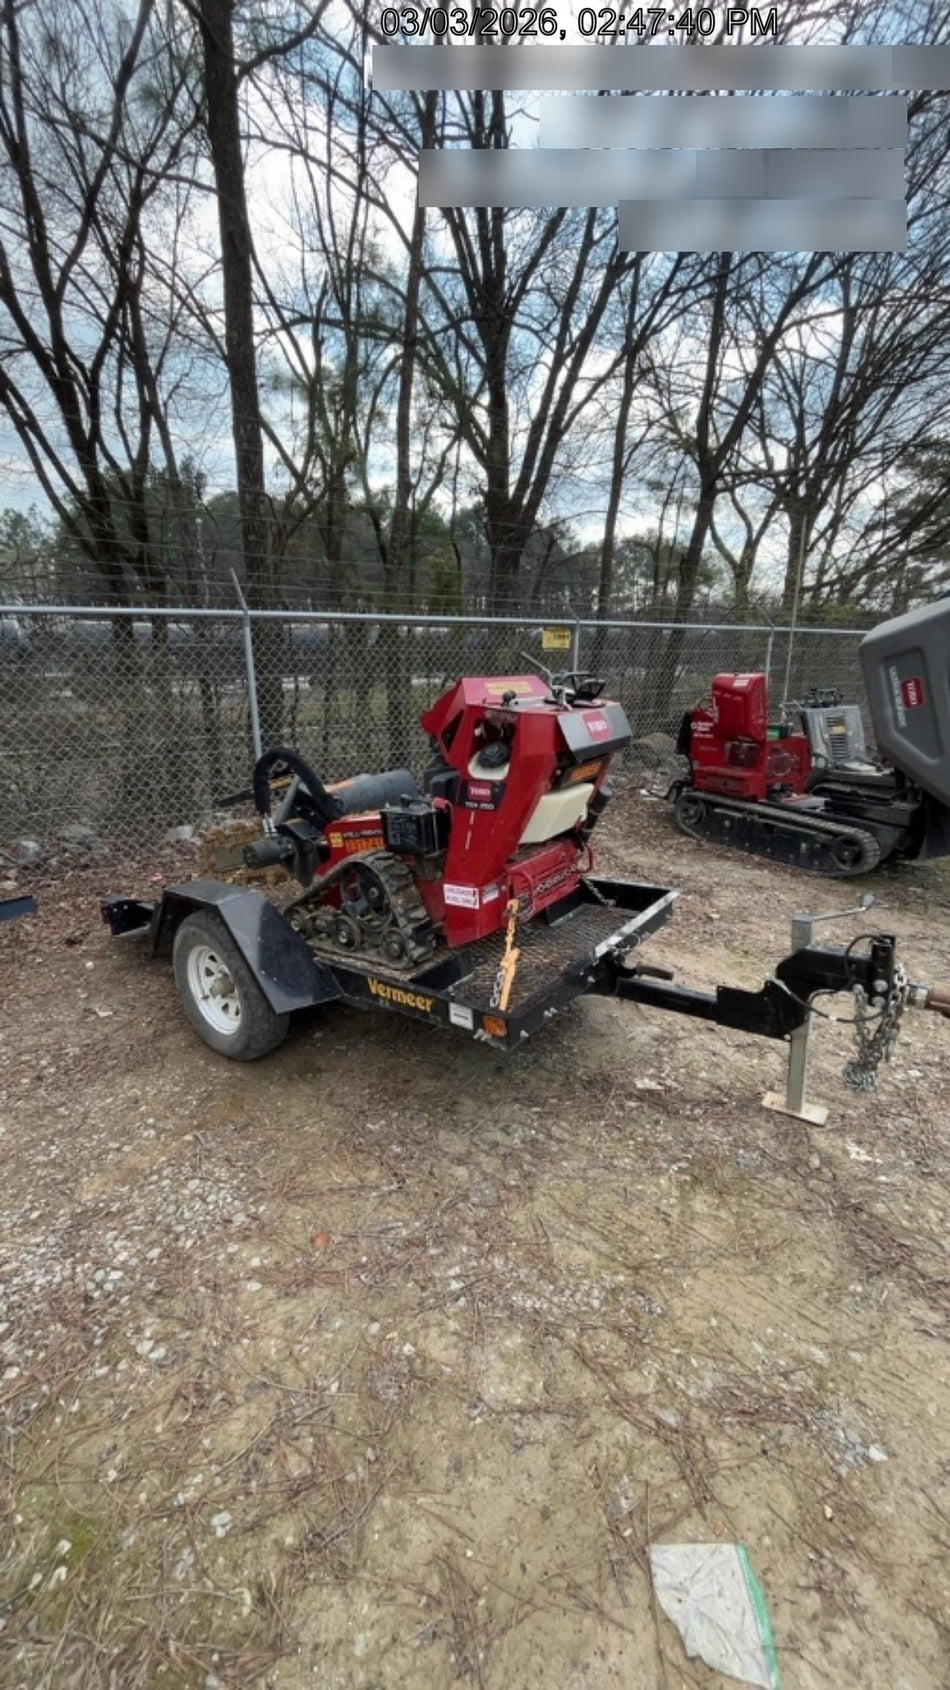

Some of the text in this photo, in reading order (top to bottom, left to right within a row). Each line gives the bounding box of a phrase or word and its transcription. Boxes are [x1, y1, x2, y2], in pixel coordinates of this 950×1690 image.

[905, 681, 918, 705] TORO
[470, 786, 491, 796] TORO
[367, 975, 433, 1013] Vermeer
